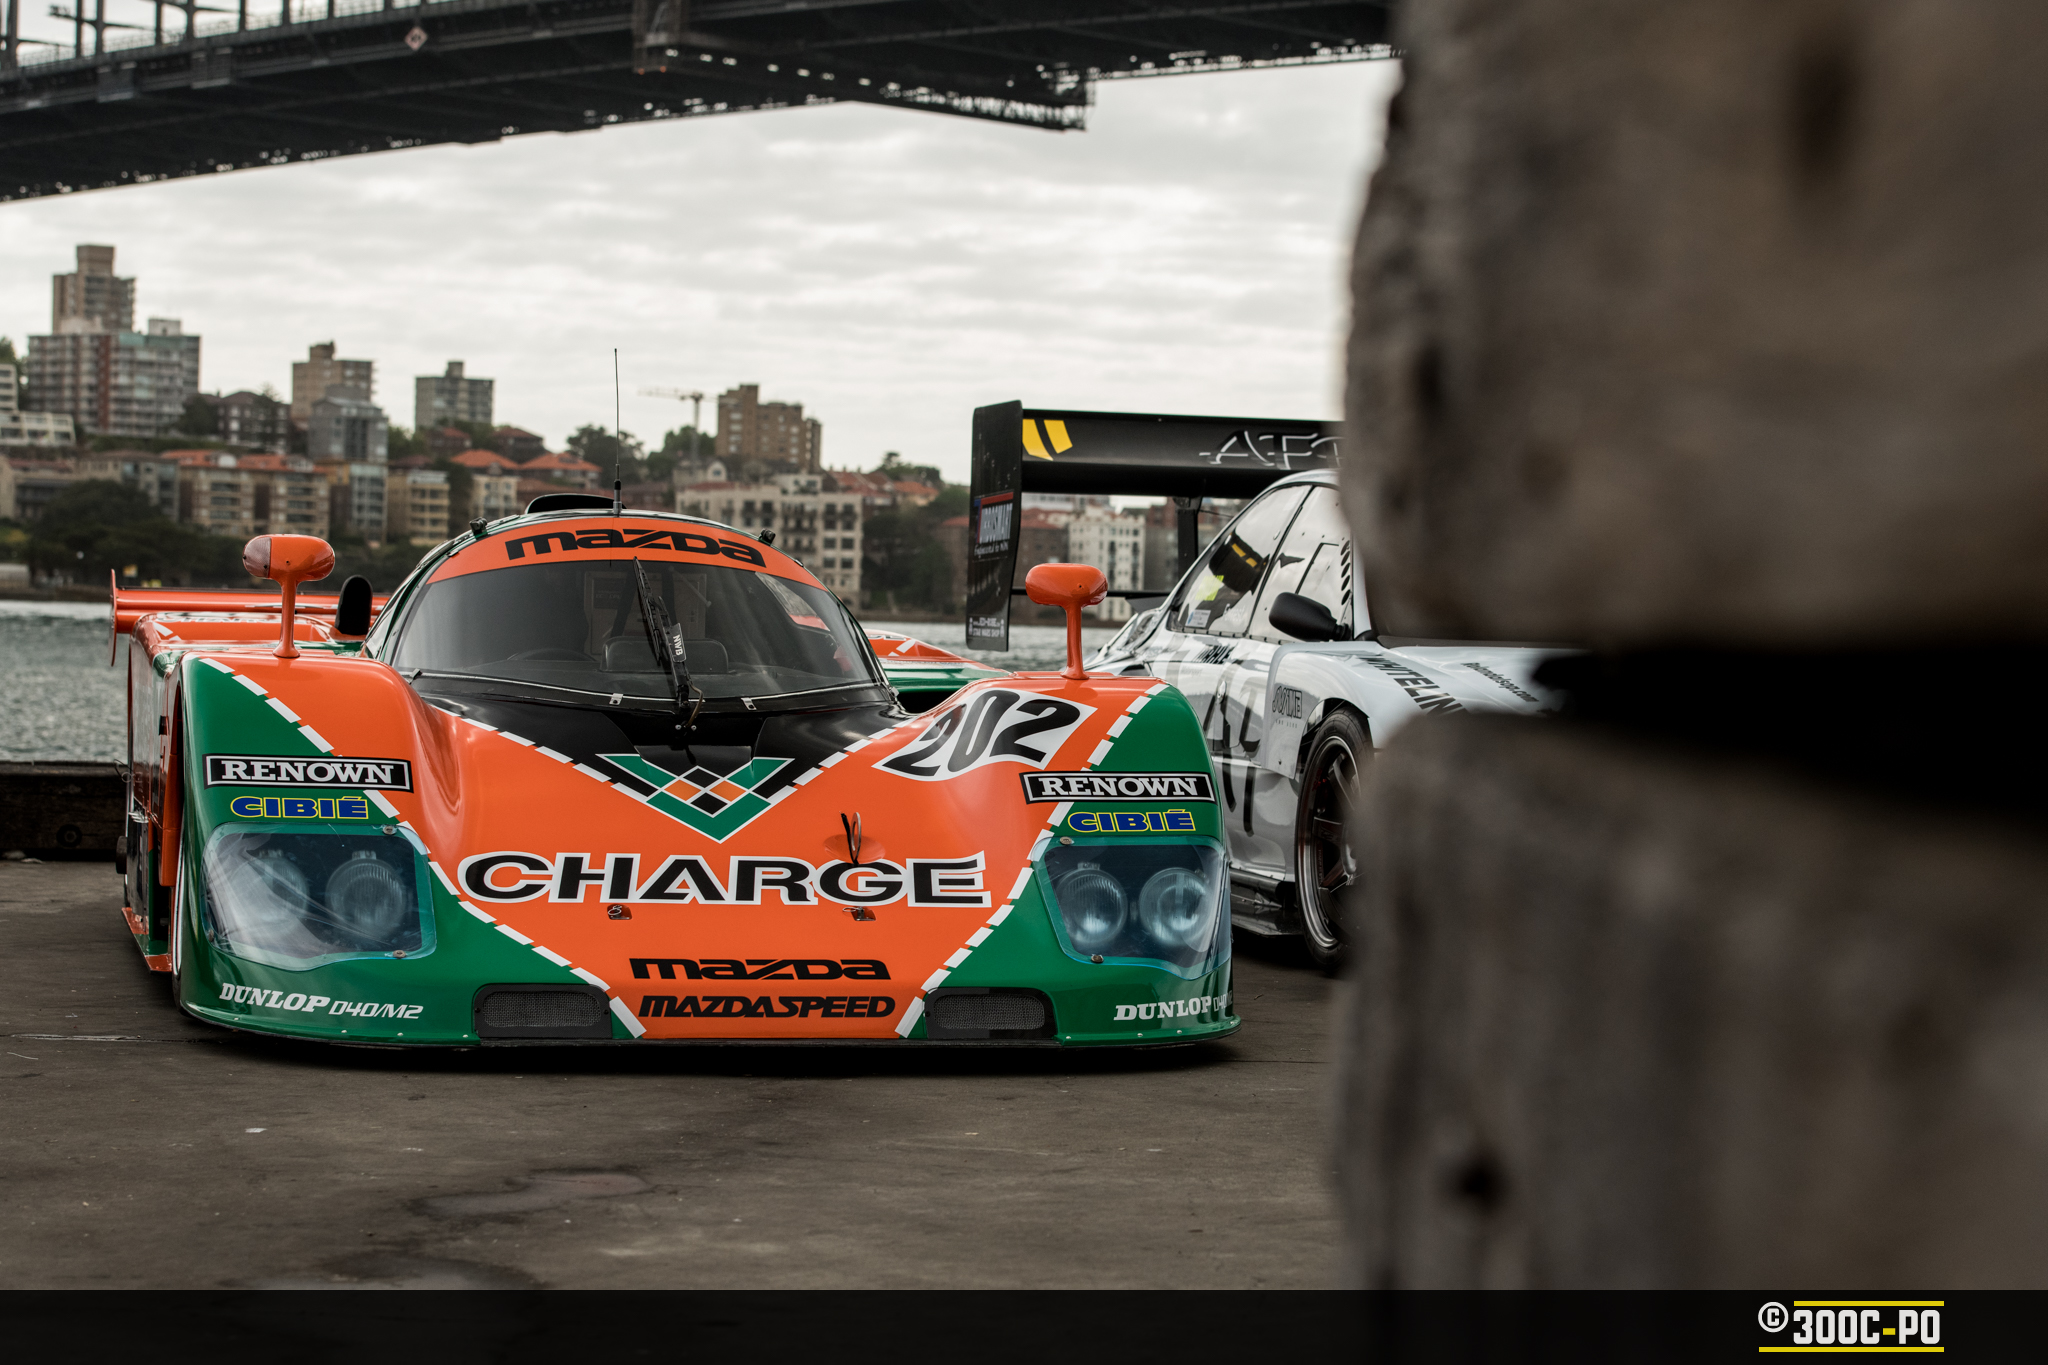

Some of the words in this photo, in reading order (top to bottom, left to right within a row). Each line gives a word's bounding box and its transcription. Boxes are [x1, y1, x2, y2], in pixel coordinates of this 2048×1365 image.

[672, 634, 684, 656] NWB
[882, 689, 1081, 777] 202
[221, 760, 394, 784] RENOWN
[1038, 777, 1198, 797] RENOWN
[230, 796, 369, 819] CIBIÉ
[1068, 809, 1196, 833] CIBIÉ
[457, 850, 992, 908] CHARGE
[219, 982, 331, 1012] DUNLOP
[328, 1000, 424, 1019] D40/M2
[638, 995, 896, 1018] MAZDASPEED
[1113, 995, 1212, 1021] DUNLOP
